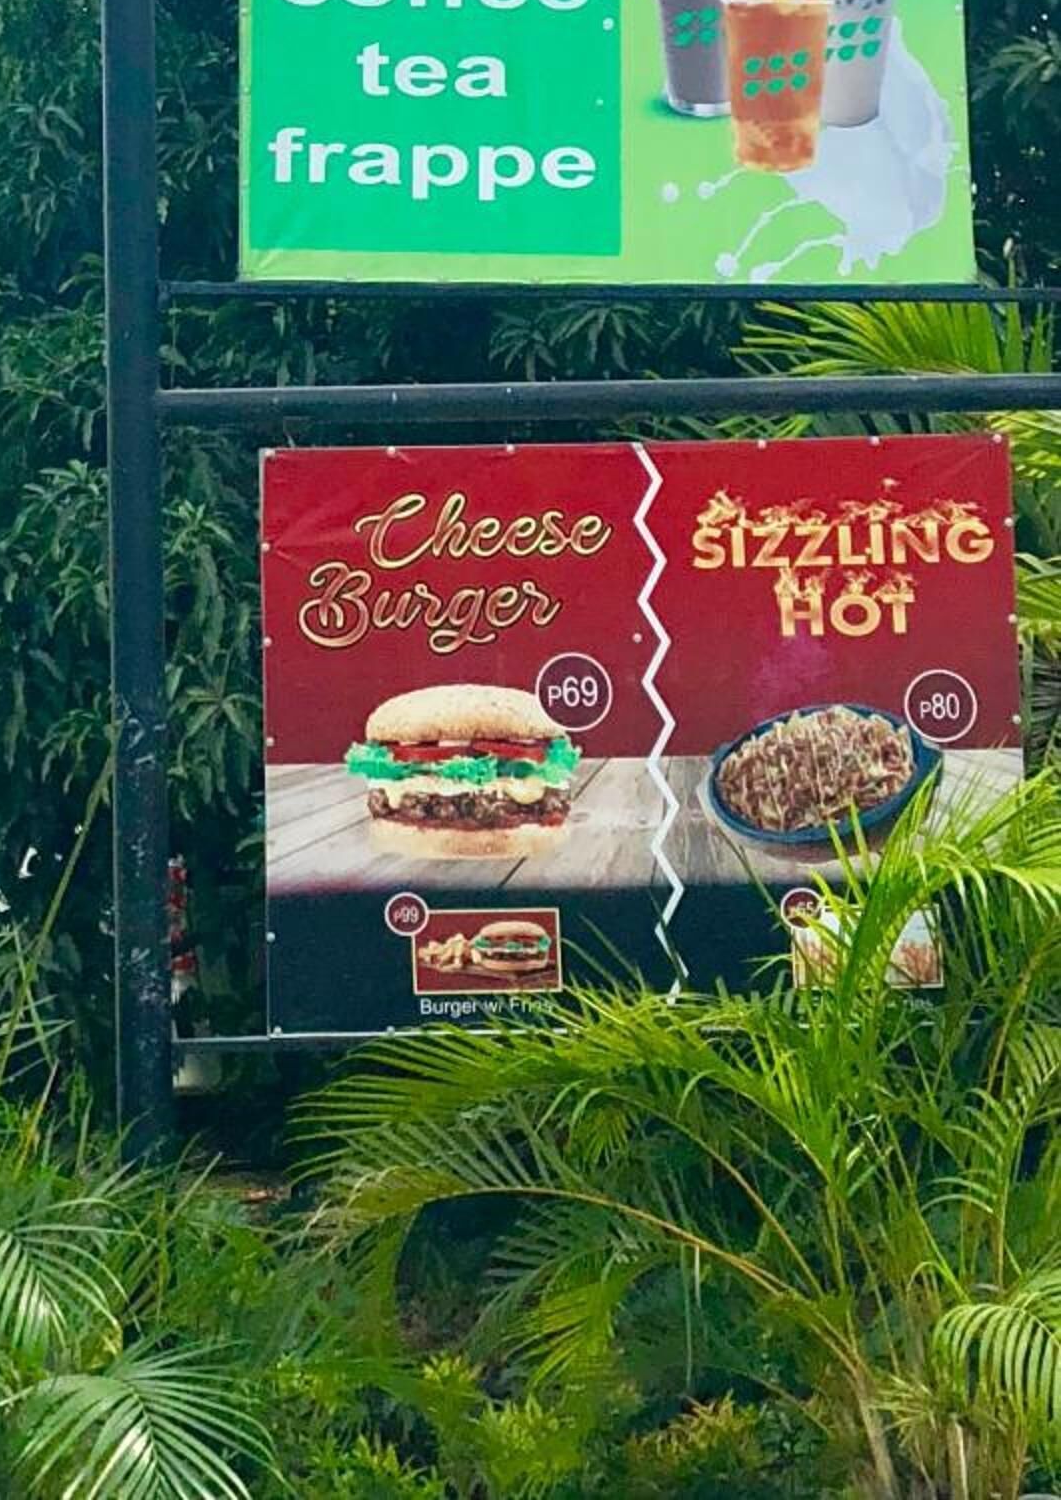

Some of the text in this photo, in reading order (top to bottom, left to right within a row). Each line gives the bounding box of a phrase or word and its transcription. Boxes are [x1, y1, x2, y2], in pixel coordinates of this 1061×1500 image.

[357, 41, 507, 97] tea
[268, 127, 596, 201] frappe
[354, 492, 613, 570] Cheese
[691, 508, 995, 569] SIZZLING
[297, 560, 562, 654] Burger
[776, 584, 916, 637] HOT
[547, 675, 599, 709] P69
[920, 692, 960, 720] P80
[419, 998, 477, 1018] Burger
